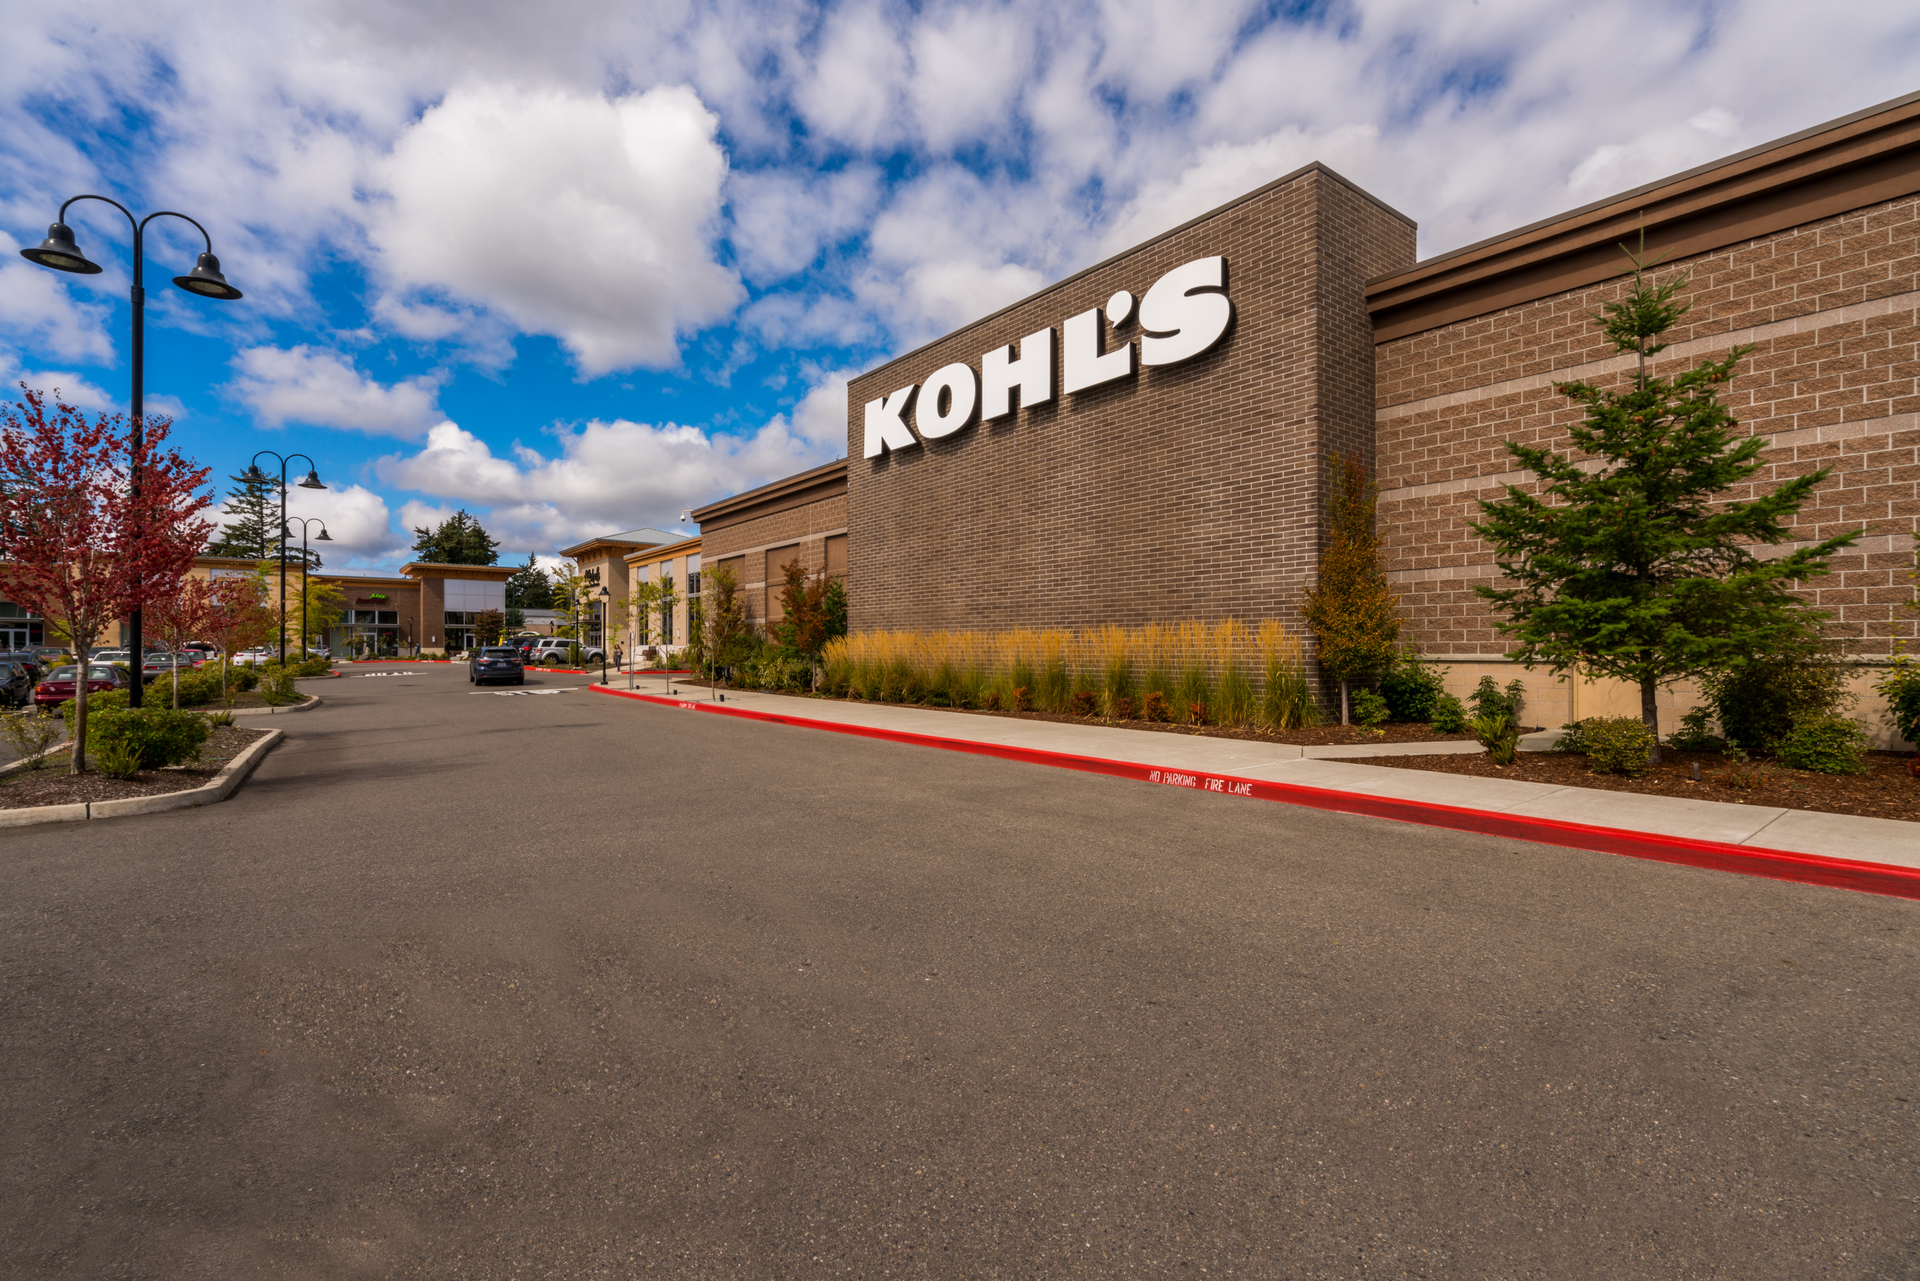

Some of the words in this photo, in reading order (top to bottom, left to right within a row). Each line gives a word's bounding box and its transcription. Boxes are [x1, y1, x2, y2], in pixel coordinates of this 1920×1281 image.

[864, 255, 1233, 459] KOHL'S
[1149, 770, 1160, 783] NO
[1162, 772, 1196, 787] PARKING
[1204, 778, 1225, 792] FIRE
[1228, 781, 1252, 796] LANE
